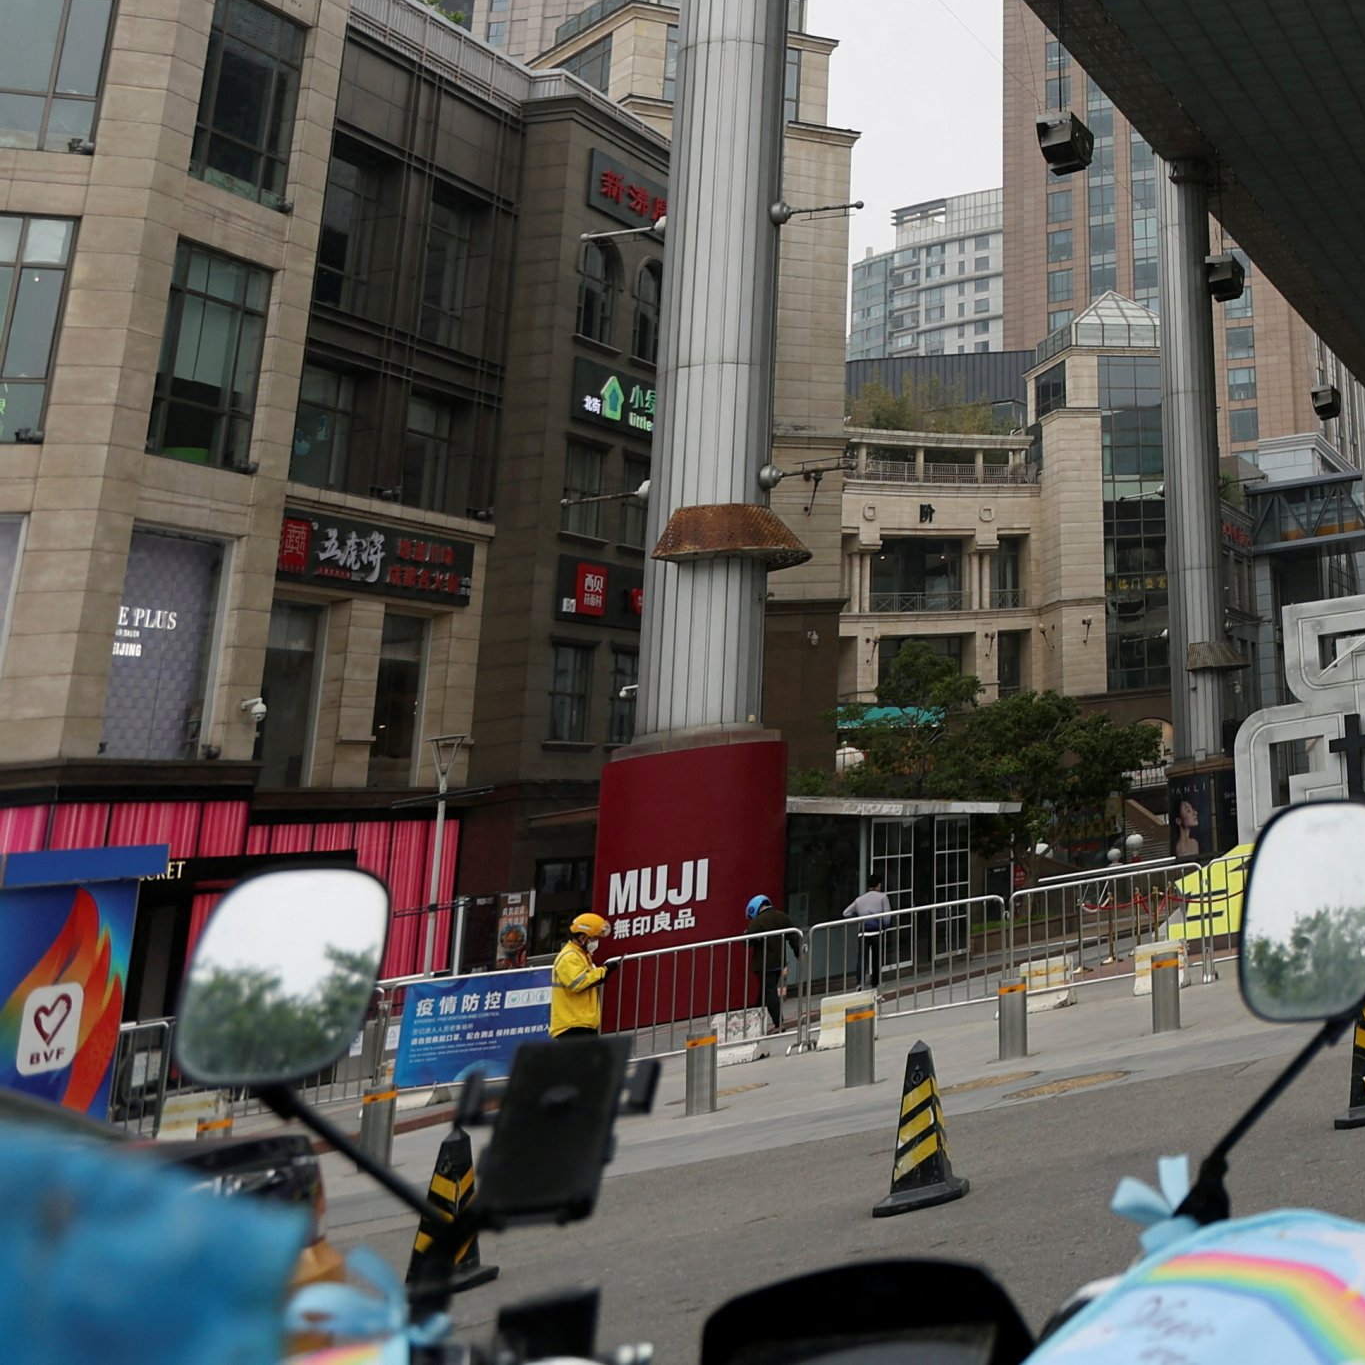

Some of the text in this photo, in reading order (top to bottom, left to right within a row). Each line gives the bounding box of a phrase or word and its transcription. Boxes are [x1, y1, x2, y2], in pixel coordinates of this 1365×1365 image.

[919, 503, 936, 524] 阶
[133, 607, 178, 631] PLUS
[608, 858, 709, 916] MUJI
[613, 907, 697, 940] 無印良品
[415, 991, 502, 1018] 疫情防控
[29, 1046, 65, 1066] BVF
